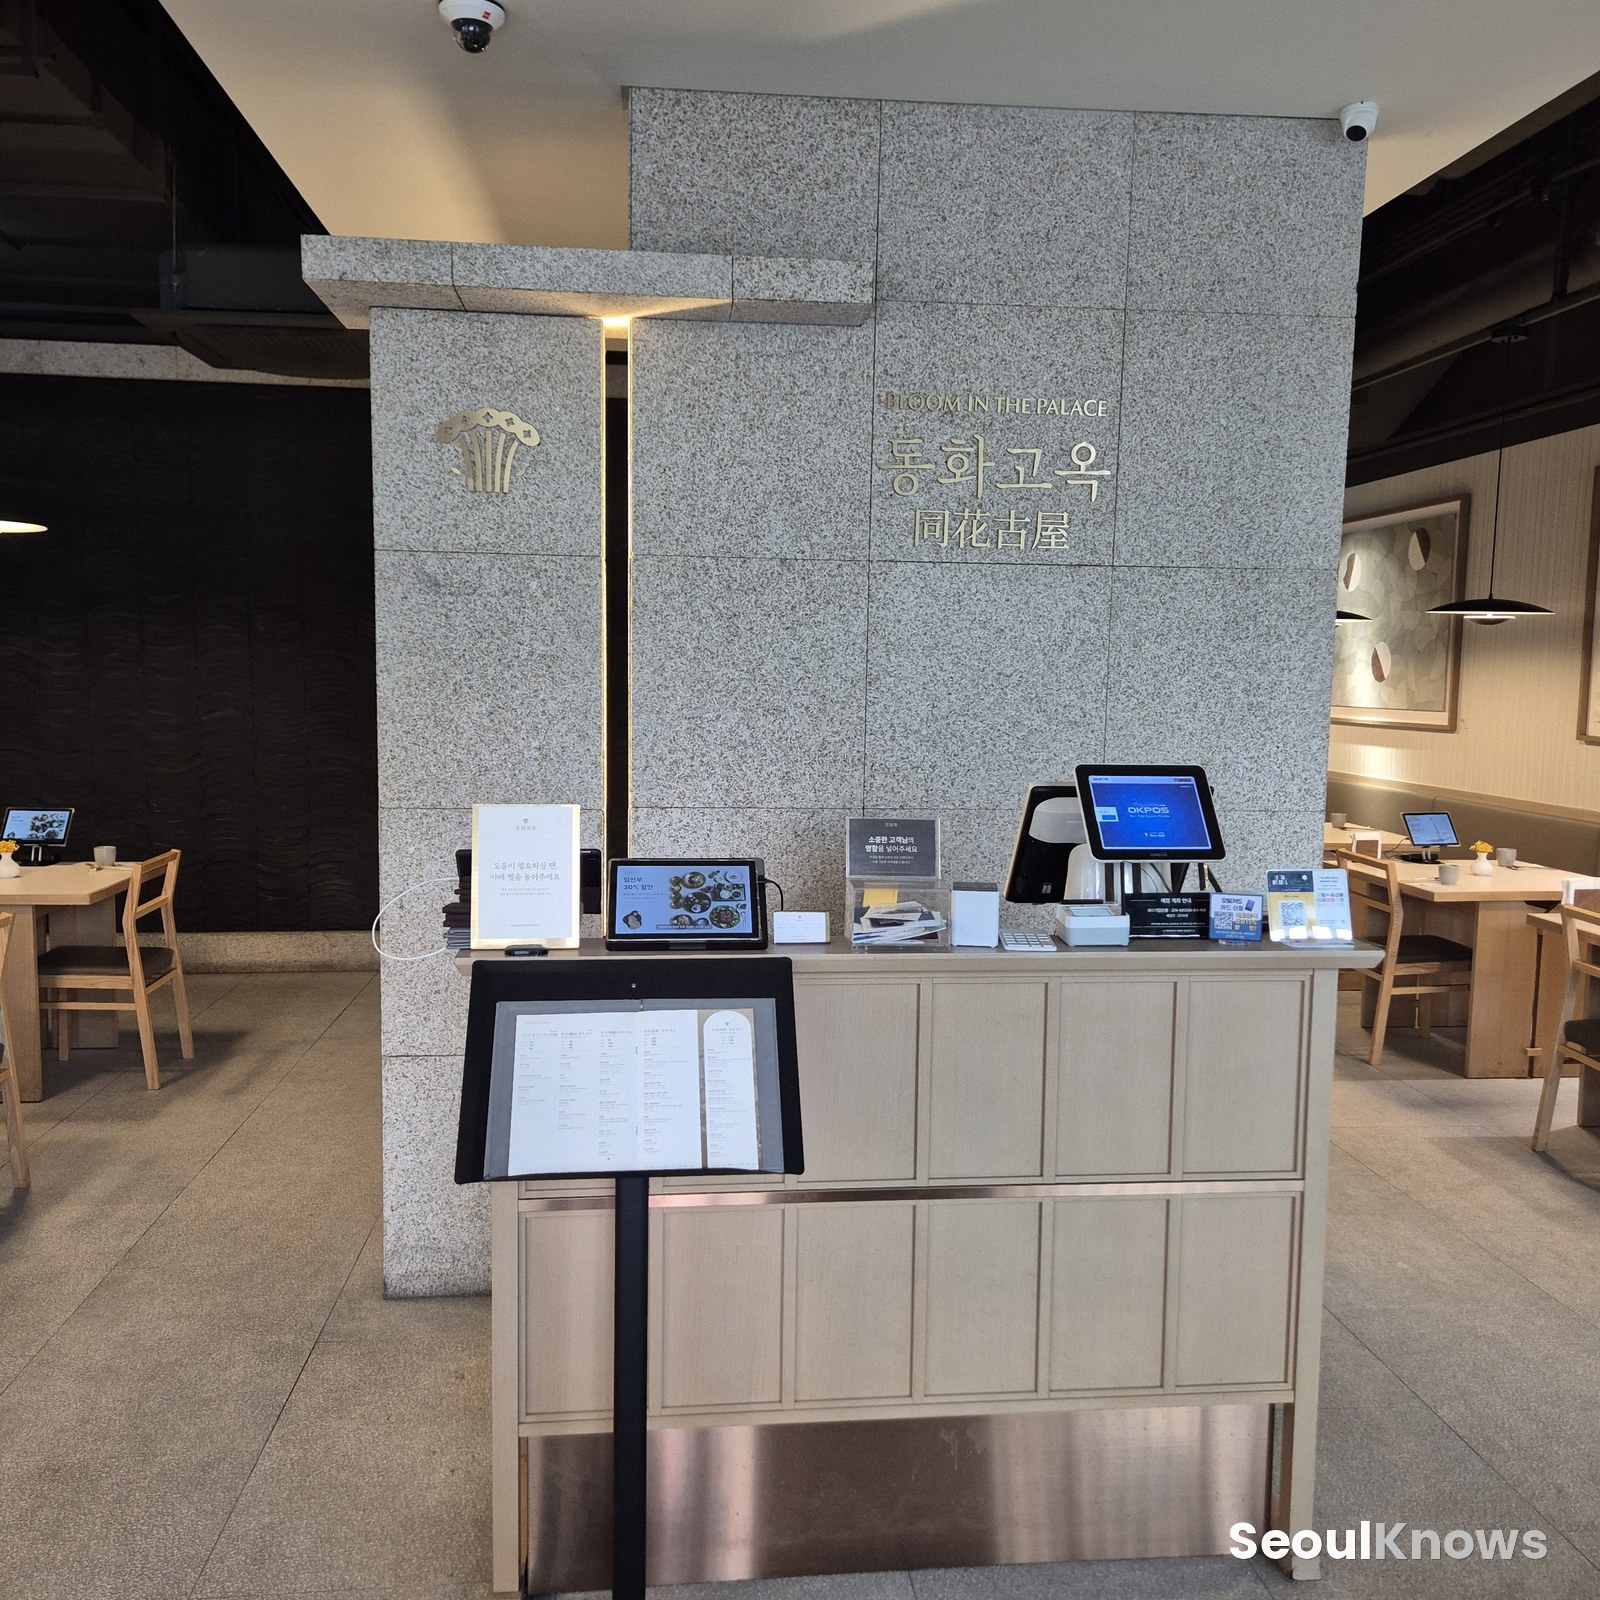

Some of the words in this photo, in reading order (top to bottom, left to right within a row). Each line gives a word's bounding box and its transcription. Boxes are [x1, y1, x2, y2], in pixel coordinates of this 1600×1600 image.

[885, 391, 960, 412] BLOOM
[968, 394, 989, 412] IN
[994, 396, 1031, 415] THE
[1036, 398, 1108, 417] PALACE
[876, 433, 1112, 503] 동화고옥
[913, 507, 1071, 550] 同花古屋
[1127, 806, 1170, 814] OKPOS
[868, 836, 888, 844] 소중한
[888, 836, 915, 844] 고객님의
[865, 844, 884, 853] 명함을
[885, 845, 918, 853] 넣어주세요
[493, 861, 515, 871] 도움이
[517, 861, 547, 871] 필요하실
[490, 872, 505, 881] 아래
[507, 872, 522, 881] 벨을
[524, 872, 561, 881] 눌러주세요
